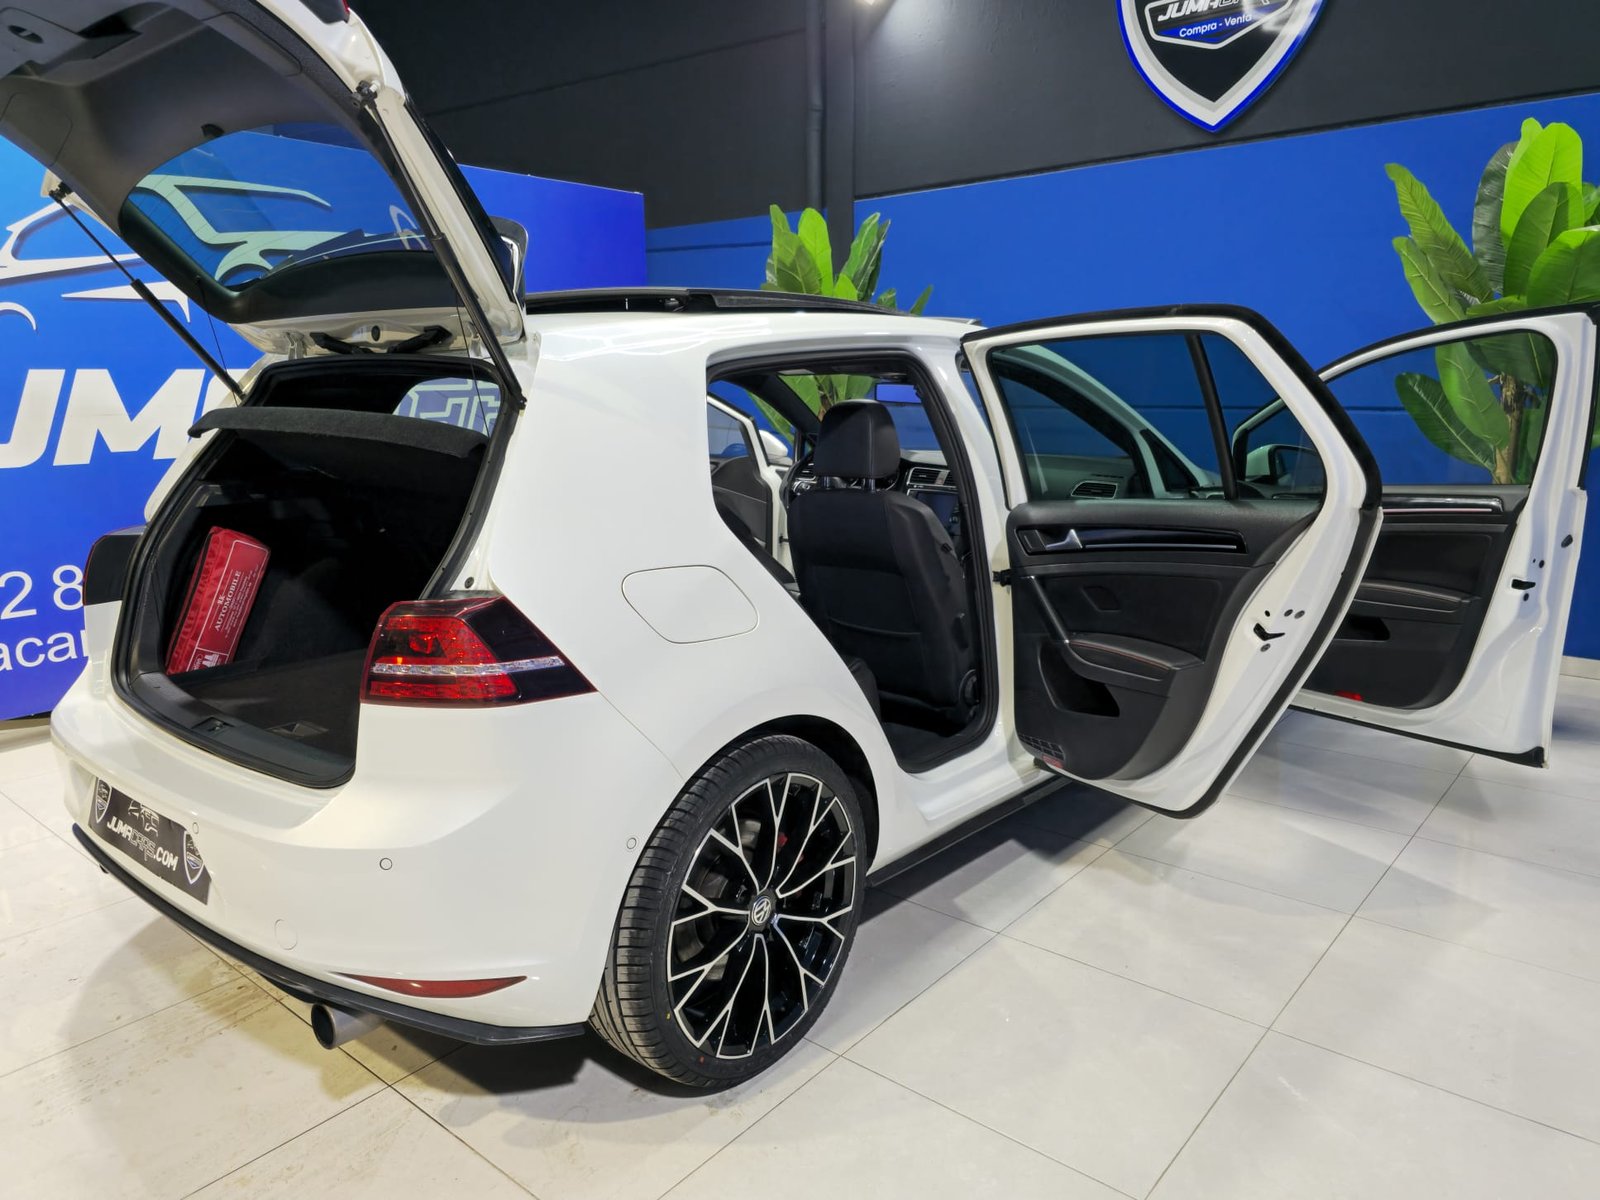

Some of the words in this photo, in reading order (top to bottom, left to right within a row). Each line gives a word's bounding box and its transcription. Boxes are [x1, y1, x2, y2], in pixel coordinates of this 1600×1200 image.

[1179, 21, 1217, 38] Compra
[1224, 13, 1252, 27] Venta
[214, 570, 242, 632] AUTOMOBILE
